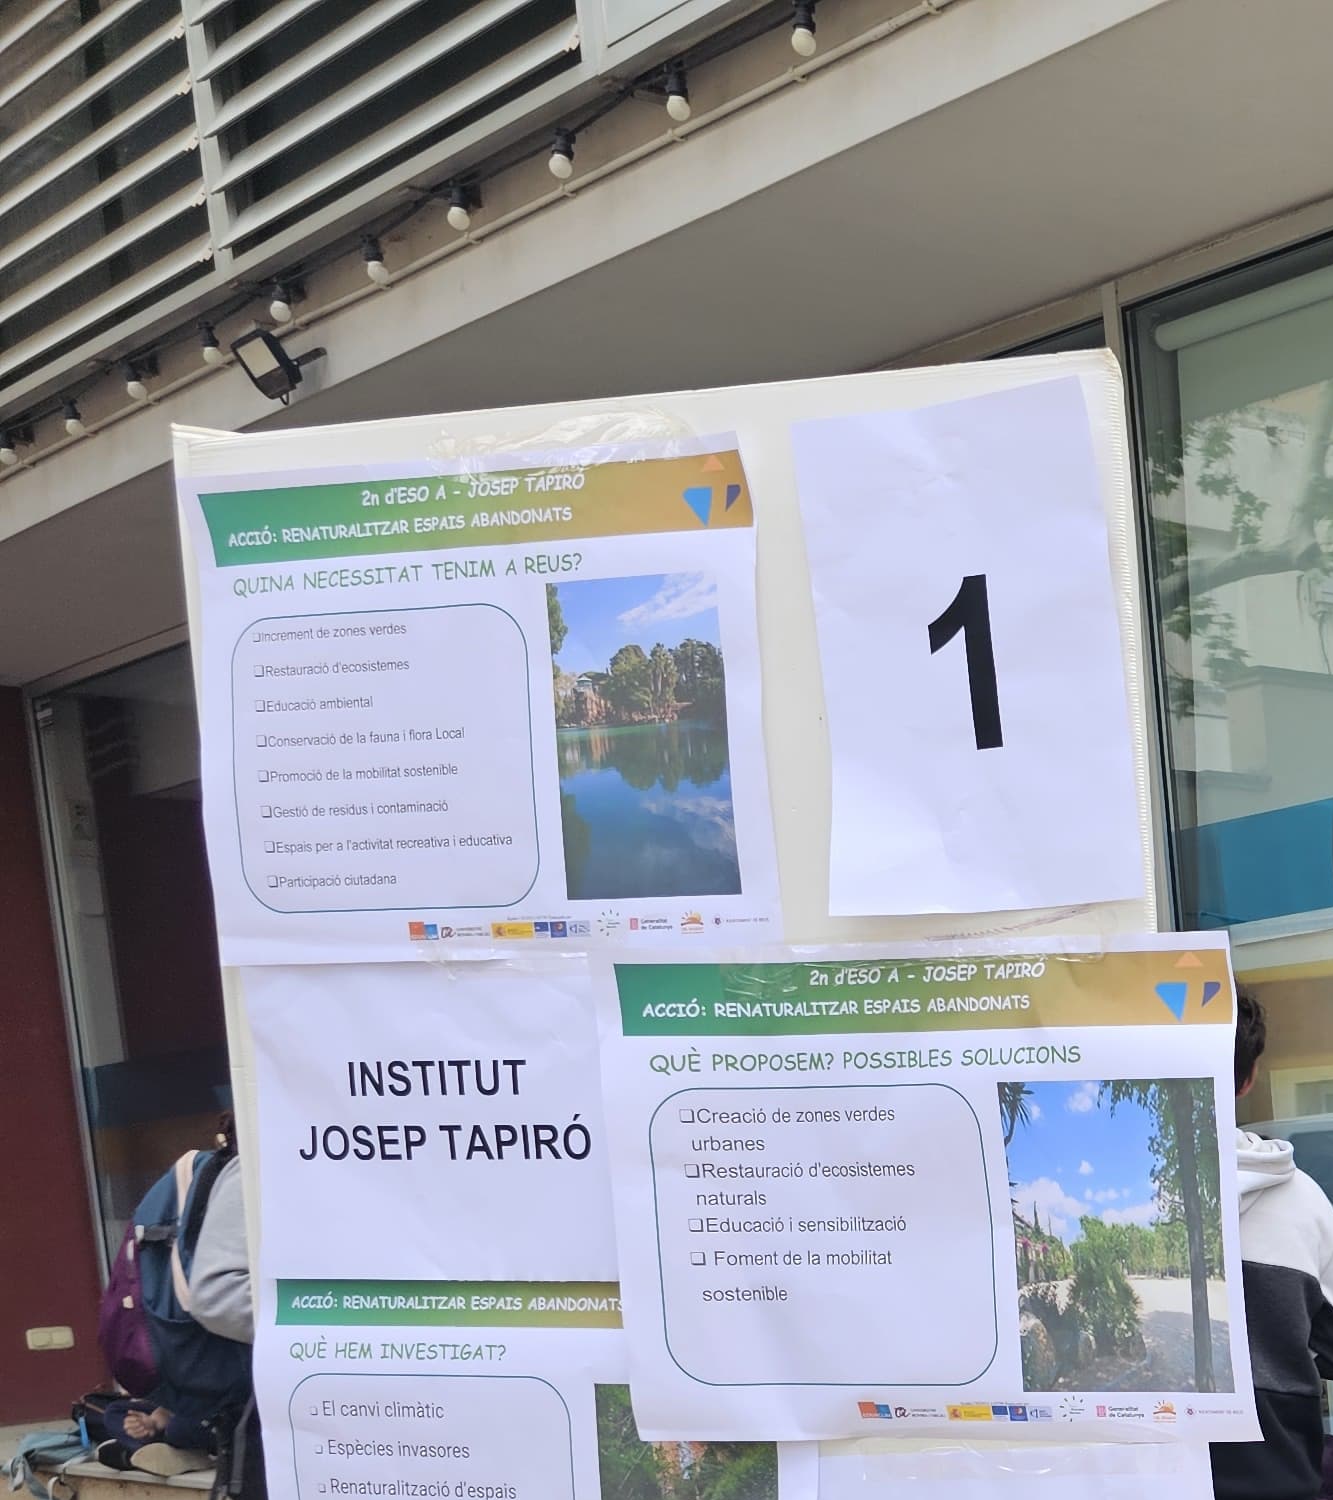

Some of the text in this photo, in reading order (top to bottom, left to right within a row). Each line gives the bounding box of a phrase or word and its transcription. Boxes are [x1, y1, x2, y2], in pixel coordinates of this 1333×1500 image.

[360, 489, 380, 507] 2n
[384, 485, 430, 505] d'ESO
[435, 484, 447, 500] A
[467, 478, 519, 498] JOSEP
[228, 506, 573, 548] ACCIÓ: RENATURALITZAR ESPAIS ABANDONATS
[233, 552, 583, 598] QUINA NECESSITAT TENIM A REUS?
[261, 622, 407, 643] Increment de zones verdes
[265, 659, 410, 678] Restauració d'ecosistemes
[927, 573, 1004, 750] 1
[266, 695, 374, 713] Educació ambiental
[267, 732, 337, 748] Conservació
[339, 733, 353, 745] de
[356, 731, 366, 744] la
[369, 730, 400, 744] fauna
[409, 728, 433, 741] flora
[435, 726, 465, 740] Local
[270, 763, 459, 783] Promoció de la mobilitat sostenible
[272, 804, 309, 818] Gestió
[311, 804, 326, 817] de
[329, 803, 369, 817] residus
[376, 799, 449, 815] contaminació
[276, 840, 313, 856] Espais
[315, 842, 334, 855] per
[336, 841, 344, 851] a
[346, 838, 394, 852] l'activitat
[396, 836, 450, 850] recreativa
[459, 833, 513, 848] educativa
[279, 873, 397, 890] Participació ciutadana
[809, 969, 829, 986] 2n
[834, 966, 882, 986] d'ESO
[887, 967, 899, 983] A
[922, 964, 977, 983] JOSEP
[984, 957, 1046, 981] TAPIRÓ
[642, 994, 1030, 1018] ACCIÓ: RENATURALITZAR ESPAIS ABANDONATS
[649, 1044, 1081, 1076] QUÈ PROPOSEM? POSSIBLES SOLUCIONS
[347, 1059, 527, 1097] INSTITUT
[696, 1105, 896, 1124] Creació de zones verdes
[299, 1113, 592, 1161] JOSEP TAPIRÓ
[691, 1136, 766, 1152] urbanes
[702, 1161, 916, 1179] Restauració d'ecosistemes
[696, 1190, 767, 1206] naturals
[705, 1215, 907, 1233] Educació i sensibilització
[713, 1249, 893, 1266] Foment de la mobilitat
[291, 1291, 338, 1309] ACCIÓ:
[342, 1295, 466, 1310] RENATURALITZAR
[471, 1295, 523, 1311] ESPAIS
[702, 1285, 788, 1302] sostenible
[289, 1335, 507, 1362] QUÈ HEM INVESTIGAT?
[321, 1400, 445, 1419] El canvi climàtic
[327, 1439, 471, 1459] Espècies invasores
[330, 1478, 450, 1498] Renaturalització
